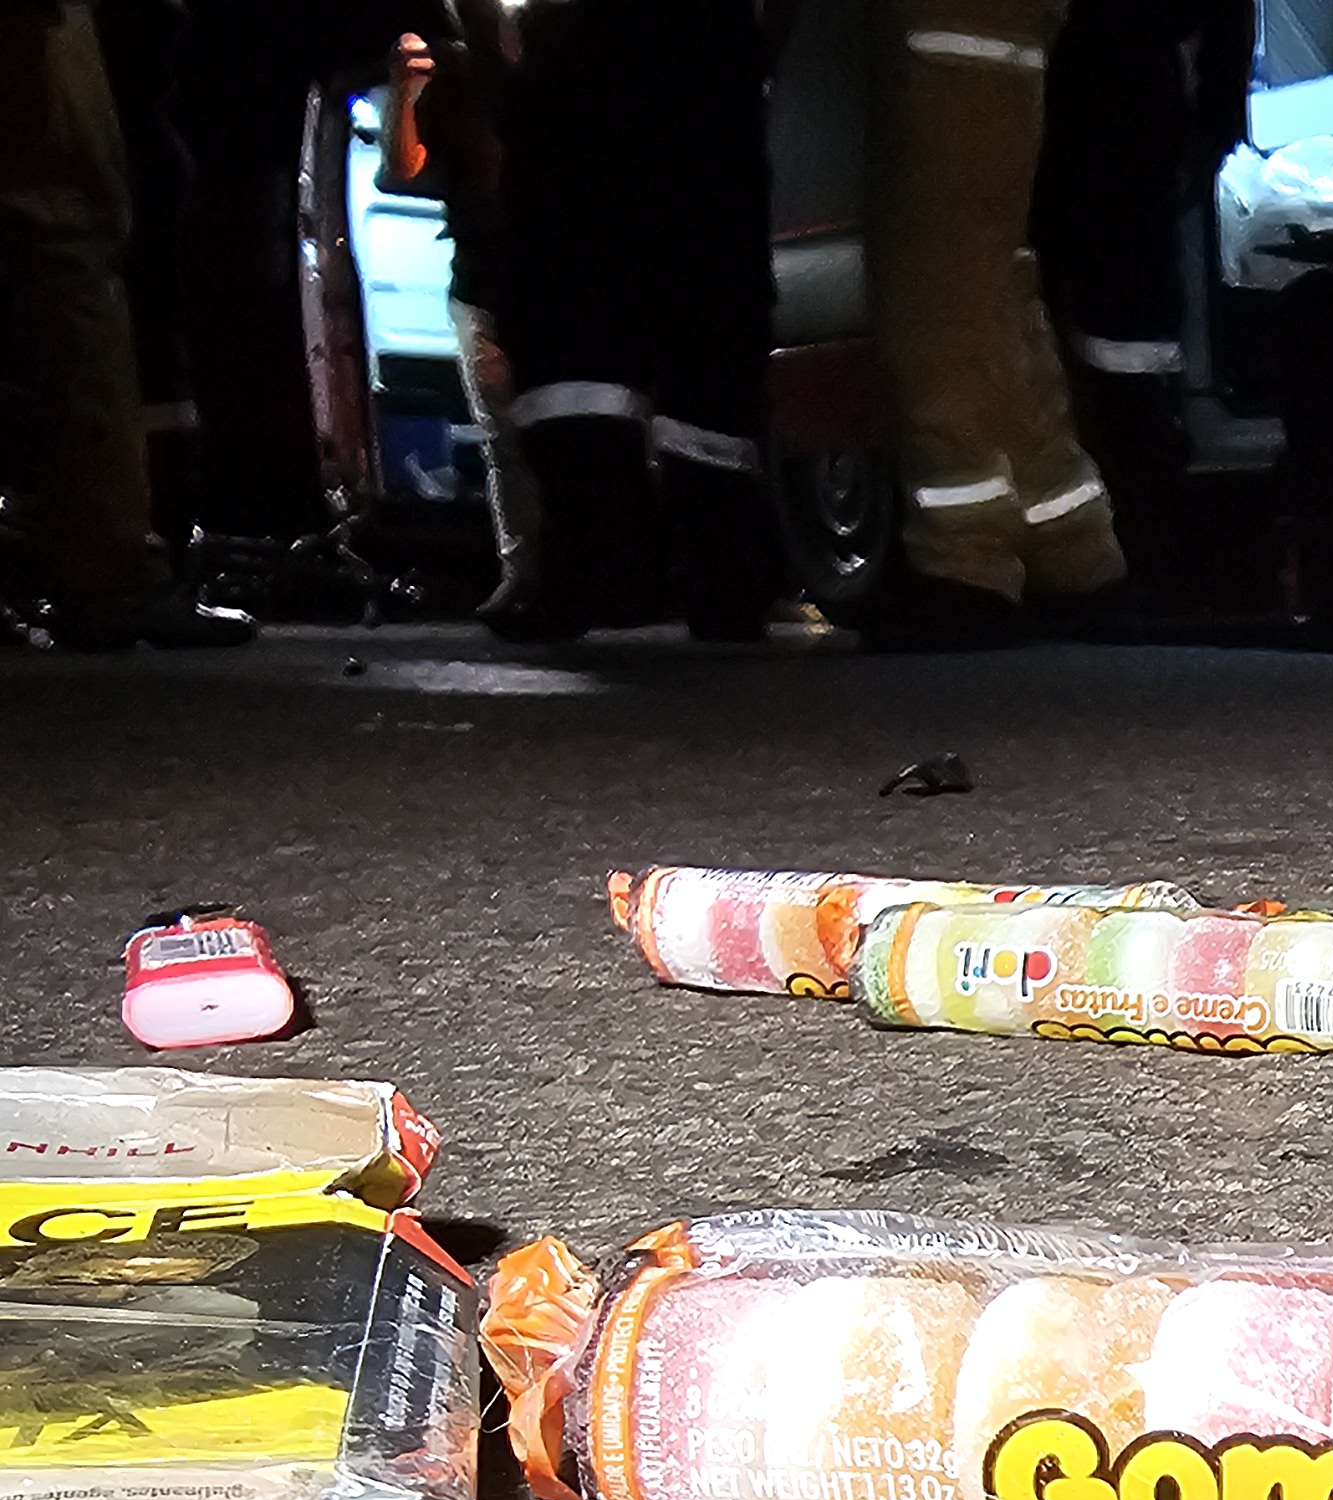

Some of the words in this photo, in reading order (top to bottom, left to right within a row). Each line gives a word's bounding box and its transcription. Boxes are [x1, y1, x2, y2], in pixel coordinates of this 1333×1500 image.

[1060, 985, 1146, 1024] Frutas
[1151, 993, 1172, 1014] e
[1178, 994, 1267, 1032] Creme
